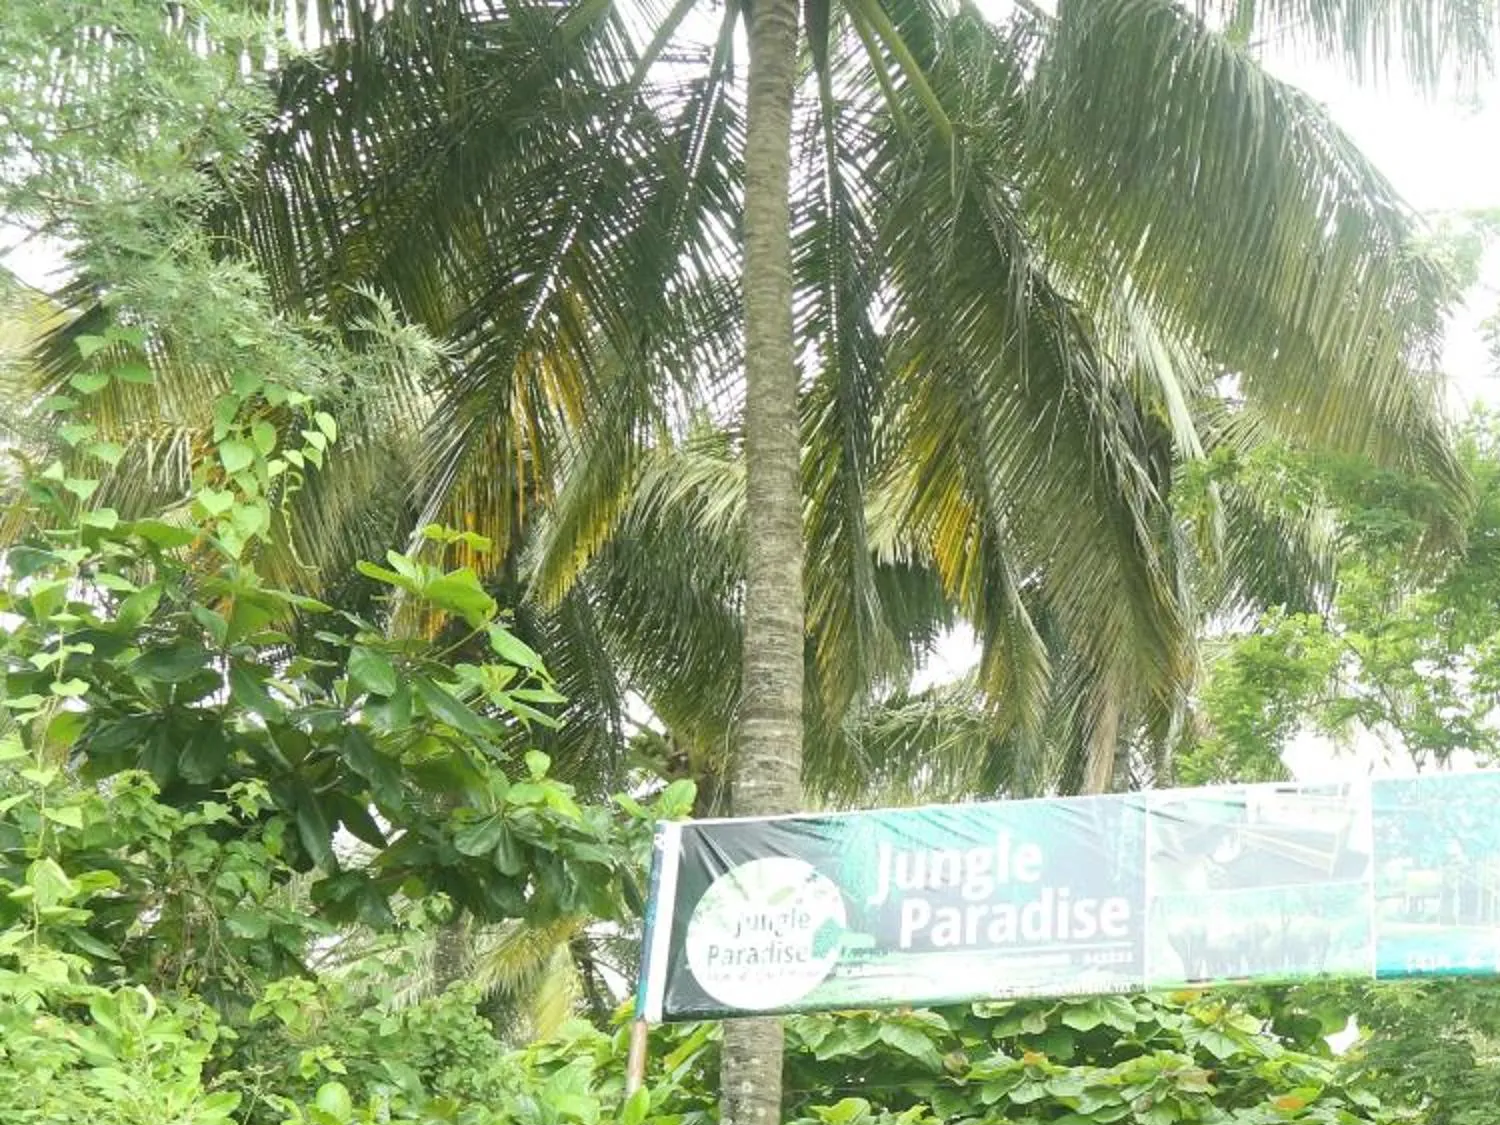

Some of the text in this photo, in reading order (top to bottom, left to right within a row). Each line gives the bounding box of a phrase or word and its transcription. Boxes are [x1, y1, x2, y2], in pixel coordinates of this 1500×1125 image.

[875, 834, 1043, 904] Jungle
[899, 888, 1131, 949] Paradise
[707, 940, 812, 967] Paradise
